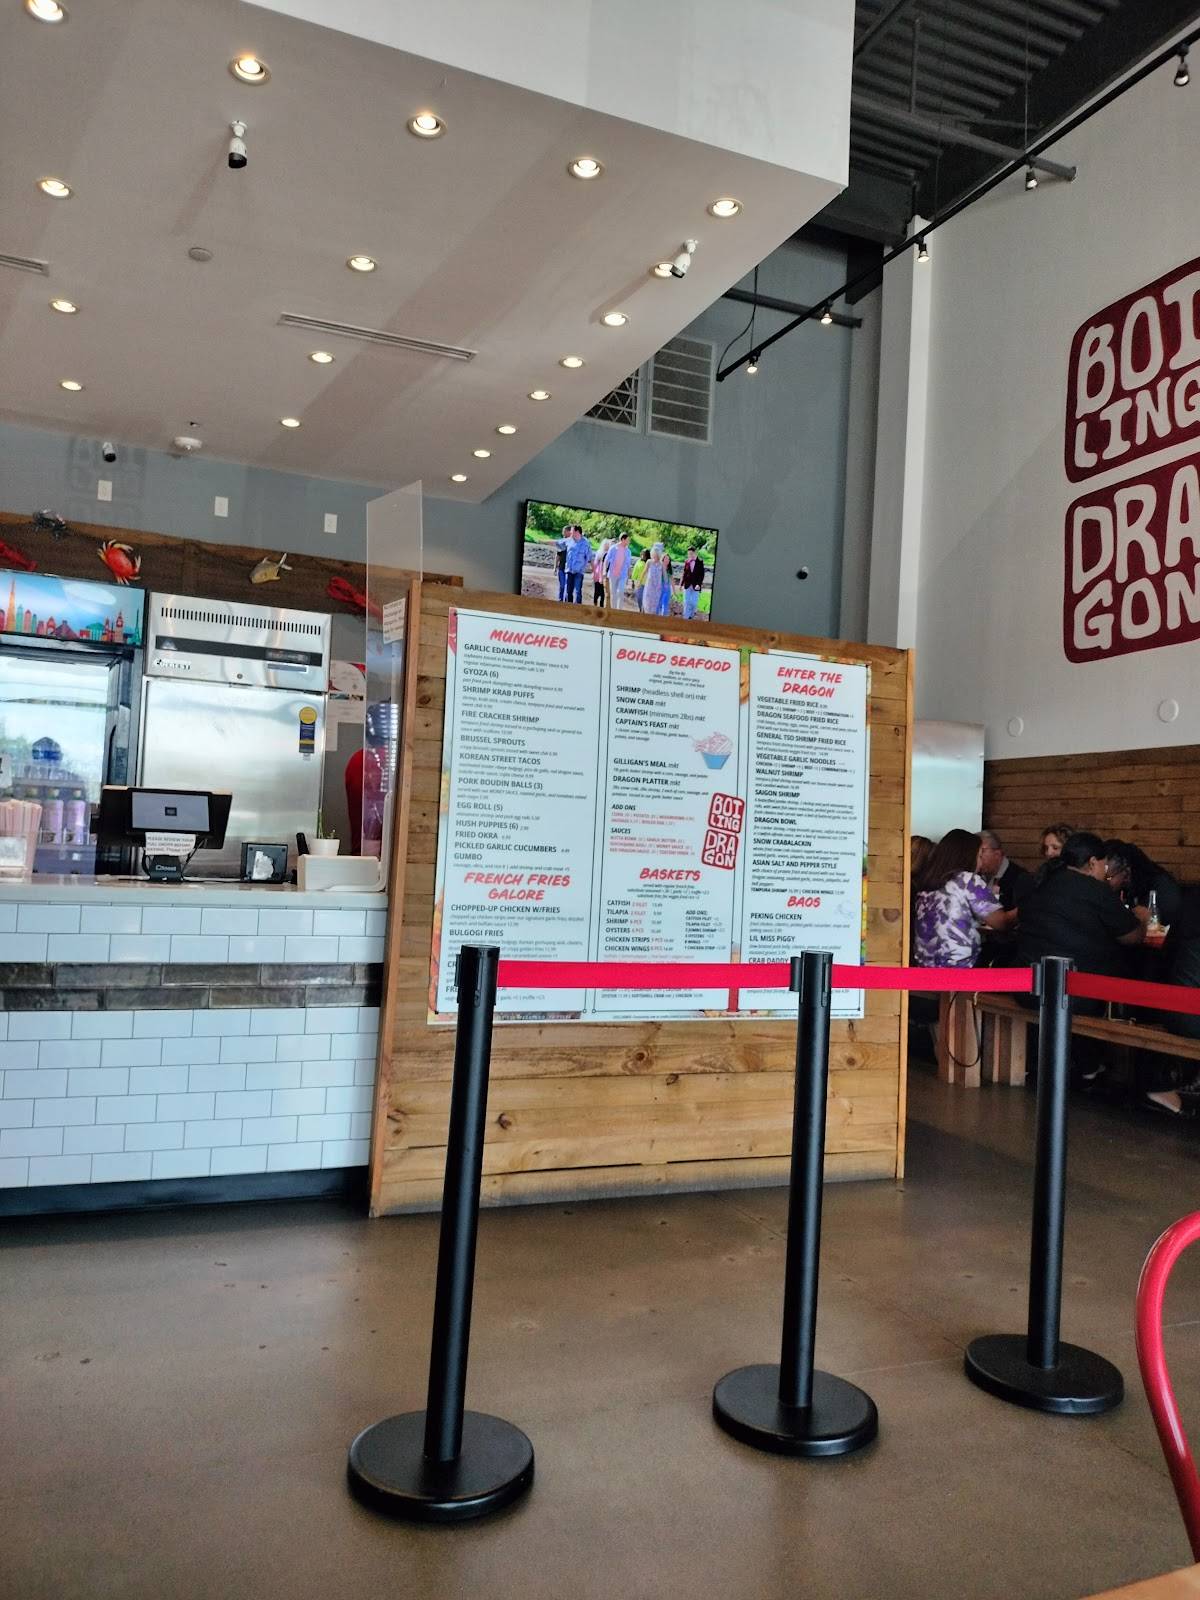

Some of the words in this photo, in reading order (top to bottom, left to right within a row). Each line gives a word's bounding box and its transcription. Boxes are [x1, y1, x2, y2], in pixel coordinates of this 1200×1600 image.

[1073, 566, 1200, 650] GON
[490, 629, 568, 650] MUNCHIES
[464, 643, 490, 653] GARLIC
[492, 646, 528, 656] EDAMAME
[616, 648, 666, 664] BOILED
[670, 655, 731, 672] SEAFOOD
[463, 668, 488, 677] GYOZA
[490, 670, 498, 678] (6)
[777, 666, 816, 680] ENTER
[819, 672, 842, 684] THE
[462, 686, 490, 694] SHRIMP
[492, 688, 511, 696] KRAB
[513, 690, 534, 699] PUFFS
[616, 685, 641, 694] SHRIMP
[642, 687, 669, 698] (headless
[782, 683, 835, 698] DRAGON
[616, 696, 636, 704] SNOW
[637, 698, 654, 706] CRAB
[757, 696, 788, 704] VEGETABLE
[461, 710, 476, 718] FIRE
[479, 711, 510, 720] CRACKER
[615, 707, 648, 716] CRAWFISH
[649, 710, 679, 719] (minimum
[757, 710, 782, 718] DRAGON
[783, 713, 809, 721] SEAFOOD
[615, 718, 648, 727] CAPTAIN'S
[460, 735, 491, 744] BRUSSEL
[493, 737, 526, 746] SPROUTS
[756, 732, 782, 740] GENERAL
[795, 736, 817, 744] SHRIMP
[459, 753, 490, 762] KOREAN
[491, 755, 516, 763] STREET
[613, 758, 648, 766] GILLIGAN'S
[650, 760, 666, 768] MEAL
[756, 753, 787, 762] VEGETABLE
[756, 768, 780, 776] WALNUT
[480, 779, 509, 787] BOUDIN
[534, 782, 542, 790] (3)
[613, 775, 640, 784] DRAGON
[642, 777, 669, 785] PLATTER
[457, 802, 472, 810] EGG
[473, 802, 492, 810] ROLL
[711, 794, 742, 819] BOI
[456, 820, 476, 828] HUSH
[479, 821, 508, 829] PUPPIES
[509, 822, 518, 830] (6)
[710, 814, 740, 832] LING
[754, 816, 779, 824] DRAGON
[454, 842, 484, 850] PICKLED
[486, 843, 512, 851] GARLIC
[514, 845, 556, 853] CUCUMBERS
[705, 831, 736, 856] DRA
[703, 849, 736, 867] GON
[464, 872, 523, 885] FRENCH
[527, 874, 570, 887] FRIES
[640, 867, 702, 881] BASKETS
[488, 888, 544, 900] GALORE
[787, 895, 821, 908] BAOS
[451, 904, 498, 912] CHOPPED-UP
